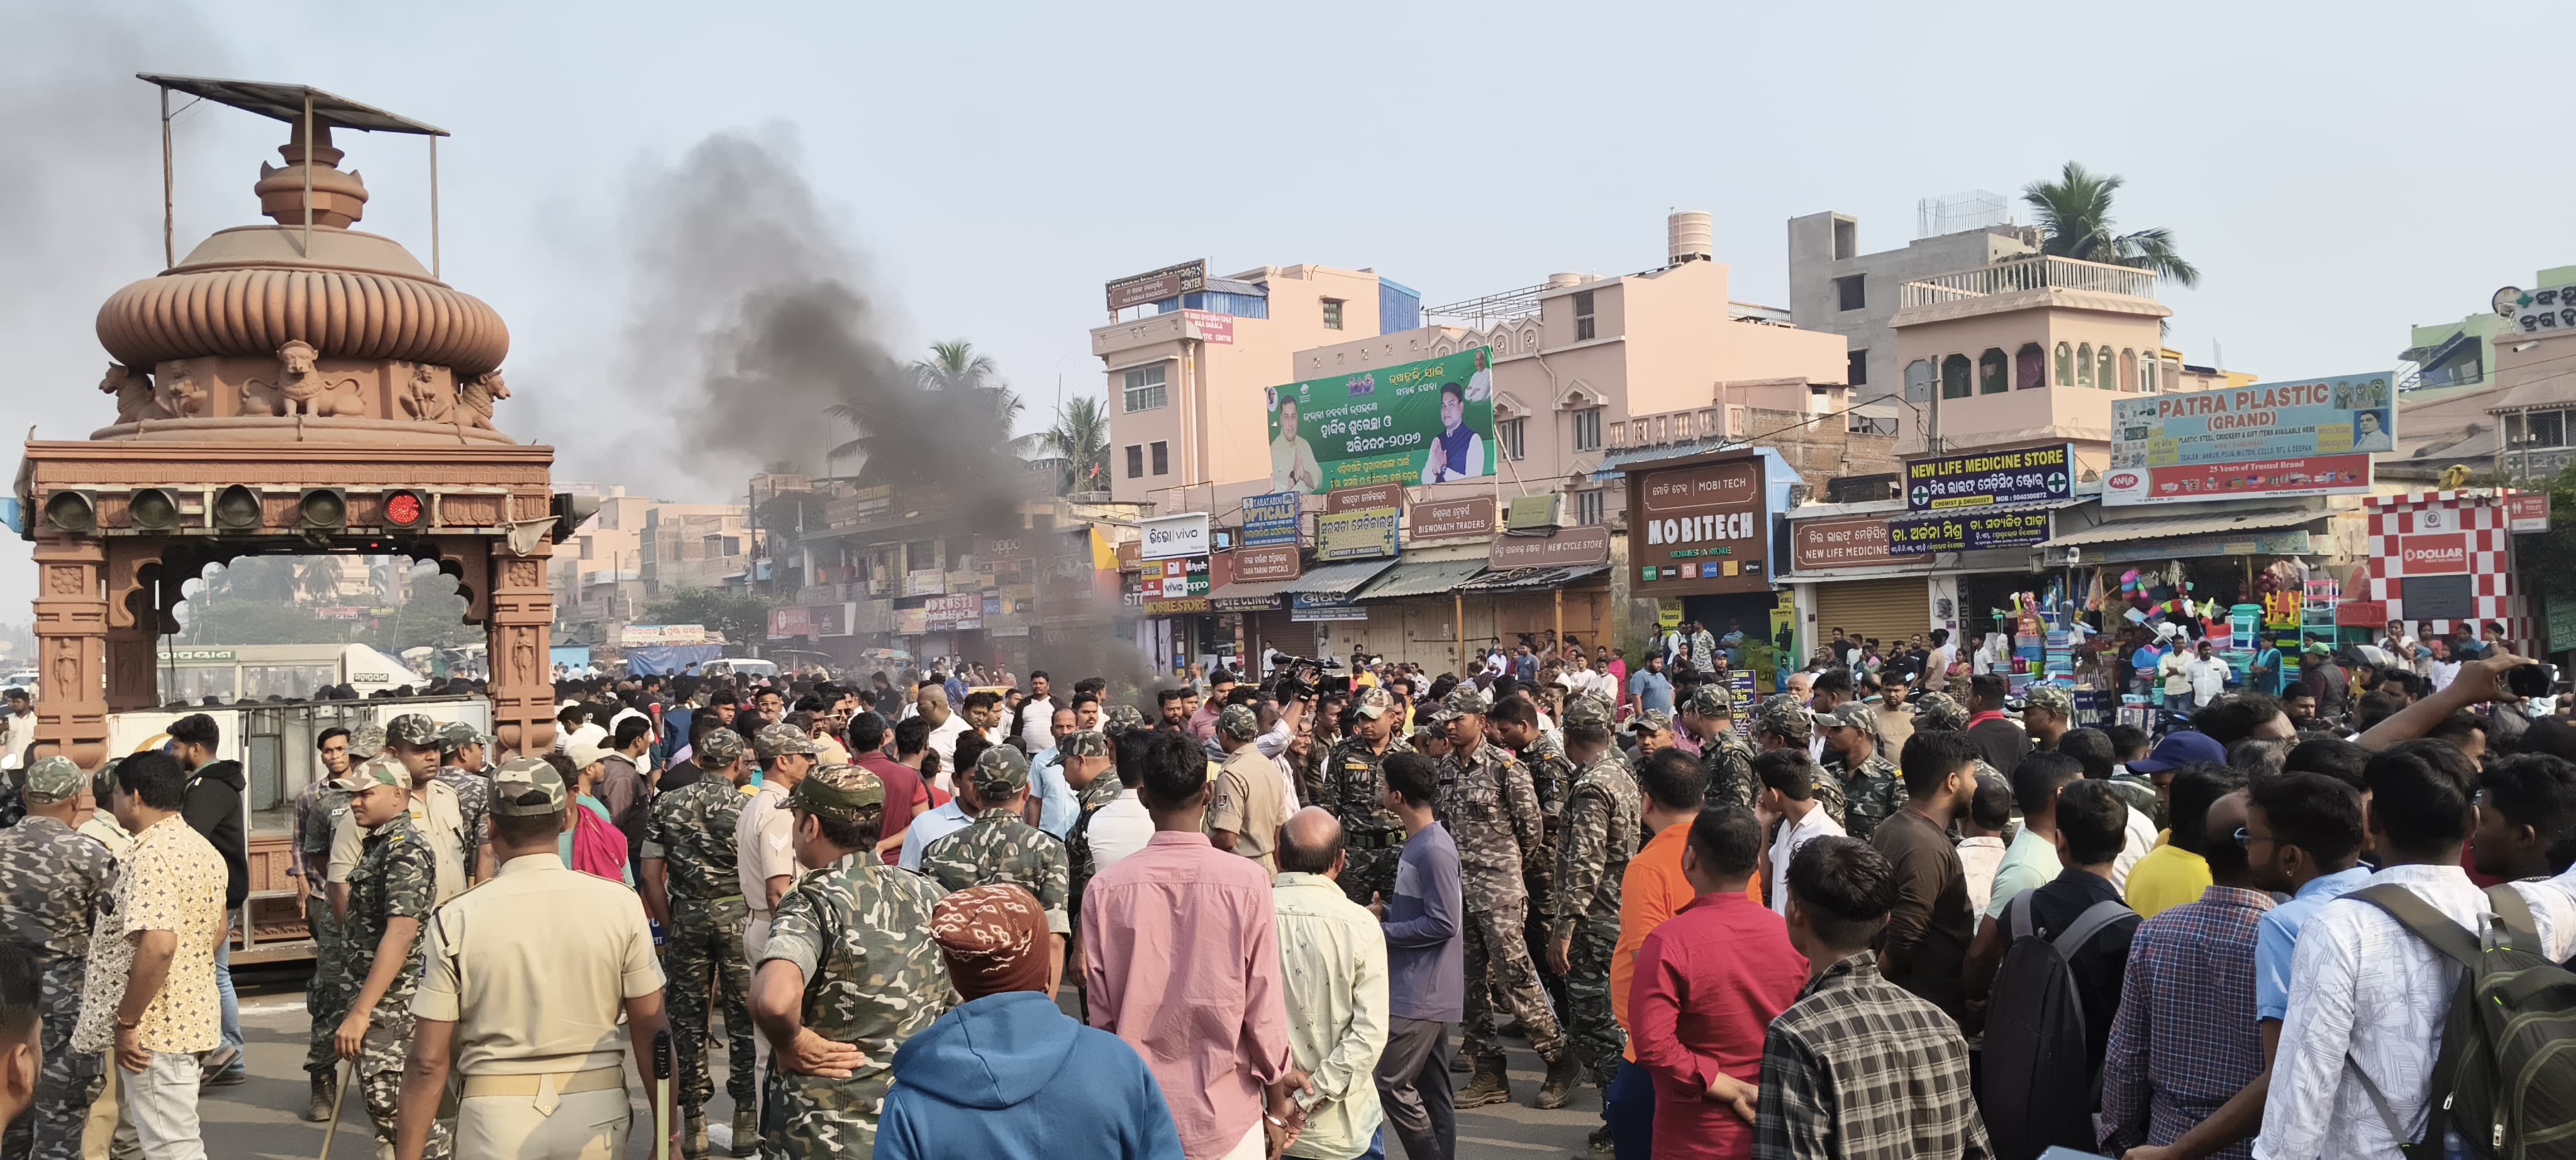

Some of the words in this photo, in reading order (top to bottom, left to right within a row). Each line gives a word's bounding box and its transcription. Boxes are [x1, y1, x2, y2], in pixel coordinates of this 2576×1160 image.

[1181, 277, 1202, 291] CENTER
[1145, 289, 1168, 298] DIAGNOSTIC
[2158, 393, 2225, 418] PATRA
[2236, 384, 2329, 411] PLASTIC
[2207, 410, 2277, 432] (GRAND)
[2216, 432, 2241, 440] CROCKERY
[2275, 427, 2302, 435] AVAILABLE
[2293, 444, 2312, 452] DEEPAK
[1911, 462, 1935, 479] NEW
[1938, 460, 1962, 476] LIFE
[1965, 454, 2021, 472] MEDICINE
[2024, 449, 2063, 467] STORE
[2220, 464, 2239, 472] Years
[2251, 462, 2279, 470] Trusted
[1699, 481, 1721, 491] MOBI
[1723, 478, 1746, 489] TECH
[1243, 504, 1295, 523] OPTICALS
[1418, 522, 1454, 533] BISWONATH
[1456, 520, 1485, 531] TRADERS
[1648, 512, 1753, 545] MOBITECH
[1175, 528, 1198, 538] vivo
[991, 538, 1021, 554] oppo
[1548, 542, 1562, 552] NEW
[1563, 541, 1582, 551] CYCLE
[1583, 540, 1602, 549] STORE
[1806, 549, 1824, 559] NEW
[1826, 548, 1843, 558] LIFE
[1846, 545, 1888, 557] MEDICINE
[1670, 549, 1699, 559] MOBILES
[1709, 547, 1731, 555] MORE
[2416, 547, 2463, 559] DOLLAR
[1191, 561, 1208, 572] Apple
[1254, 566, 1268, 574] TARINI
[1269, 565, 1289, 573] OPTICALS
[1165, 582, 1184, 592] vivo
[1187, 581, 1208, 591] oppo
[984, 605, 999, 613] vivo
[1660, 601, 1680, 610] MOBILE
[1958, 594, 1968, 640] MEDI
